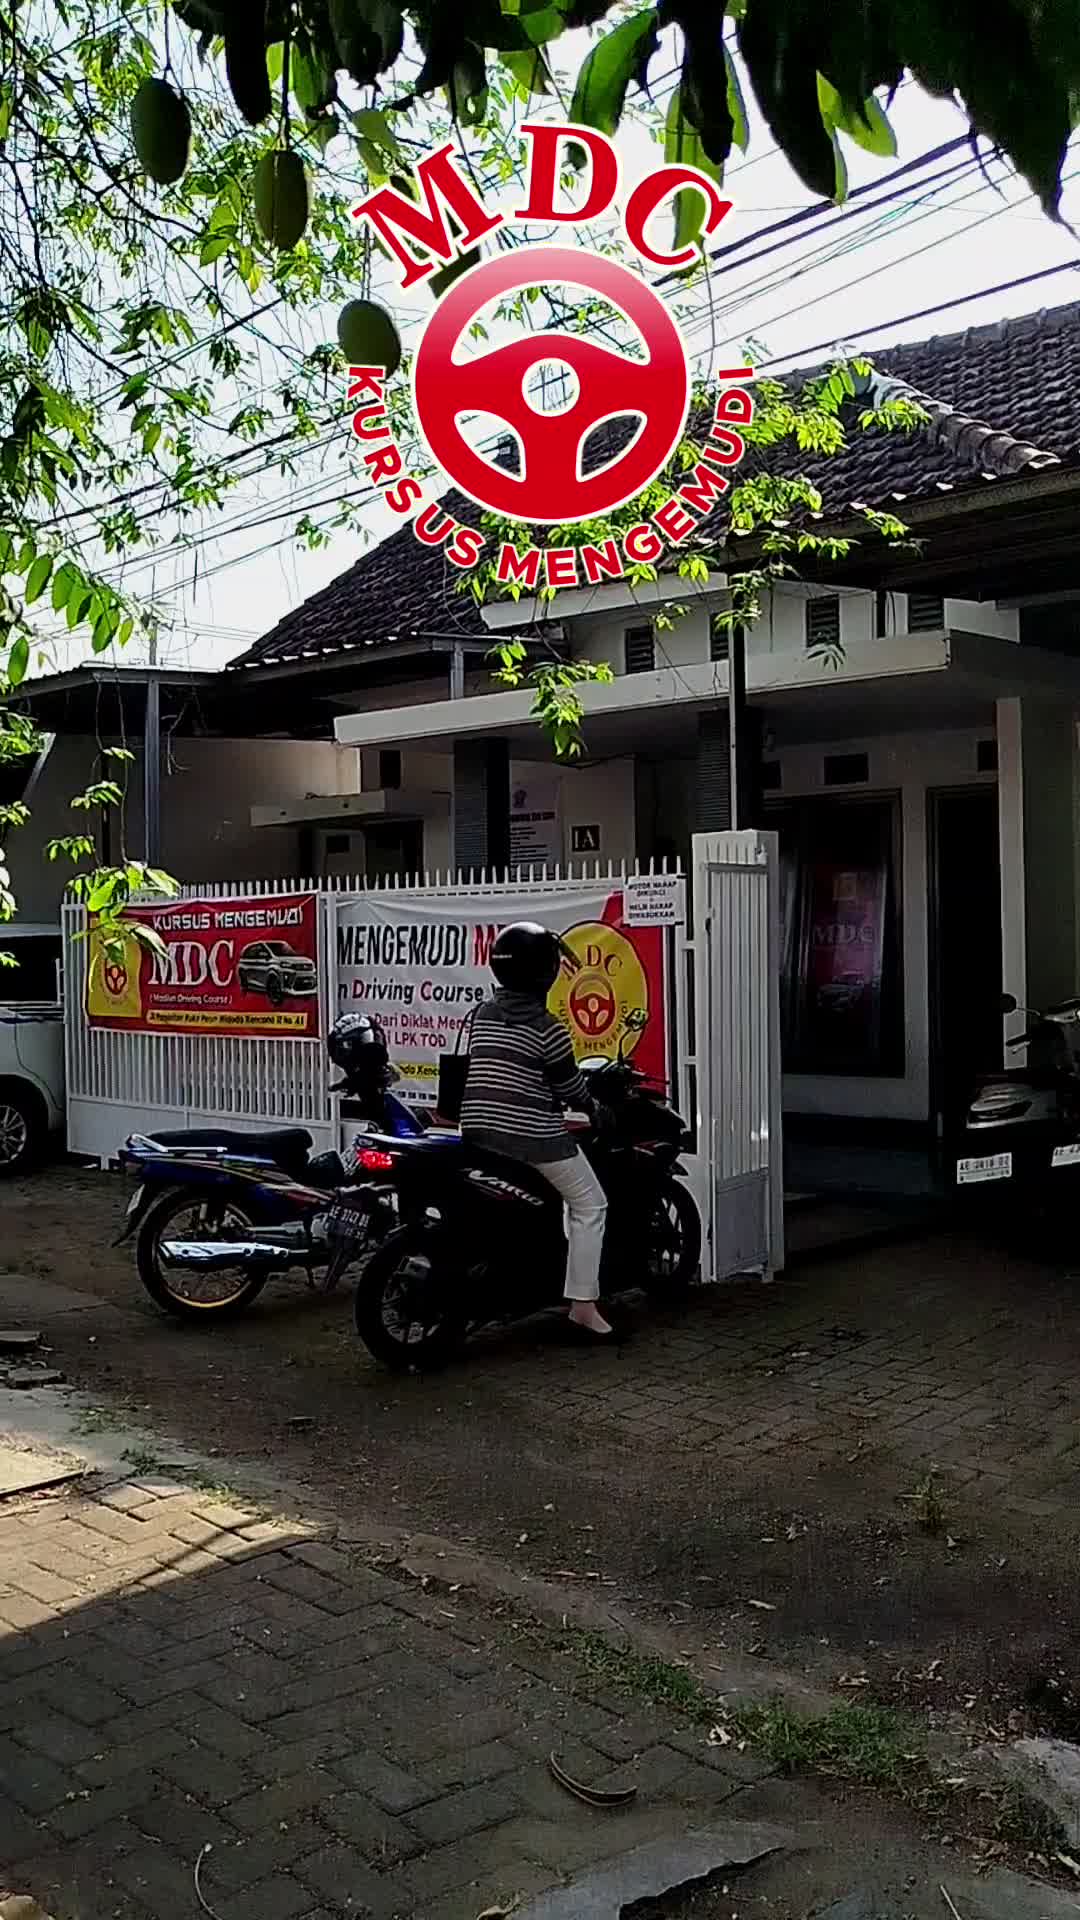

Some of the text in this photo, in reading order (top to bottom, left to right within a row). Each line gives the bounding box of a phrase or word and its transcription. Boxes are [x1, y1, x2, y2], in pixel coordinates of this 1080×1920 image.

[153, 906, 304, 931] KURSUS MENGEMUDI
[336, 924, 467, 967] MENGEMUDI
[148, 940, 234, 986] MDC
[562, 943, 624, 981] MDC
[352, 977, 415, 1006] Driving
[420, 980, 484, 1003] Course
[401, 1014, 434, 1029] Diklat
[394, 1031, 418, 1047] LPK
